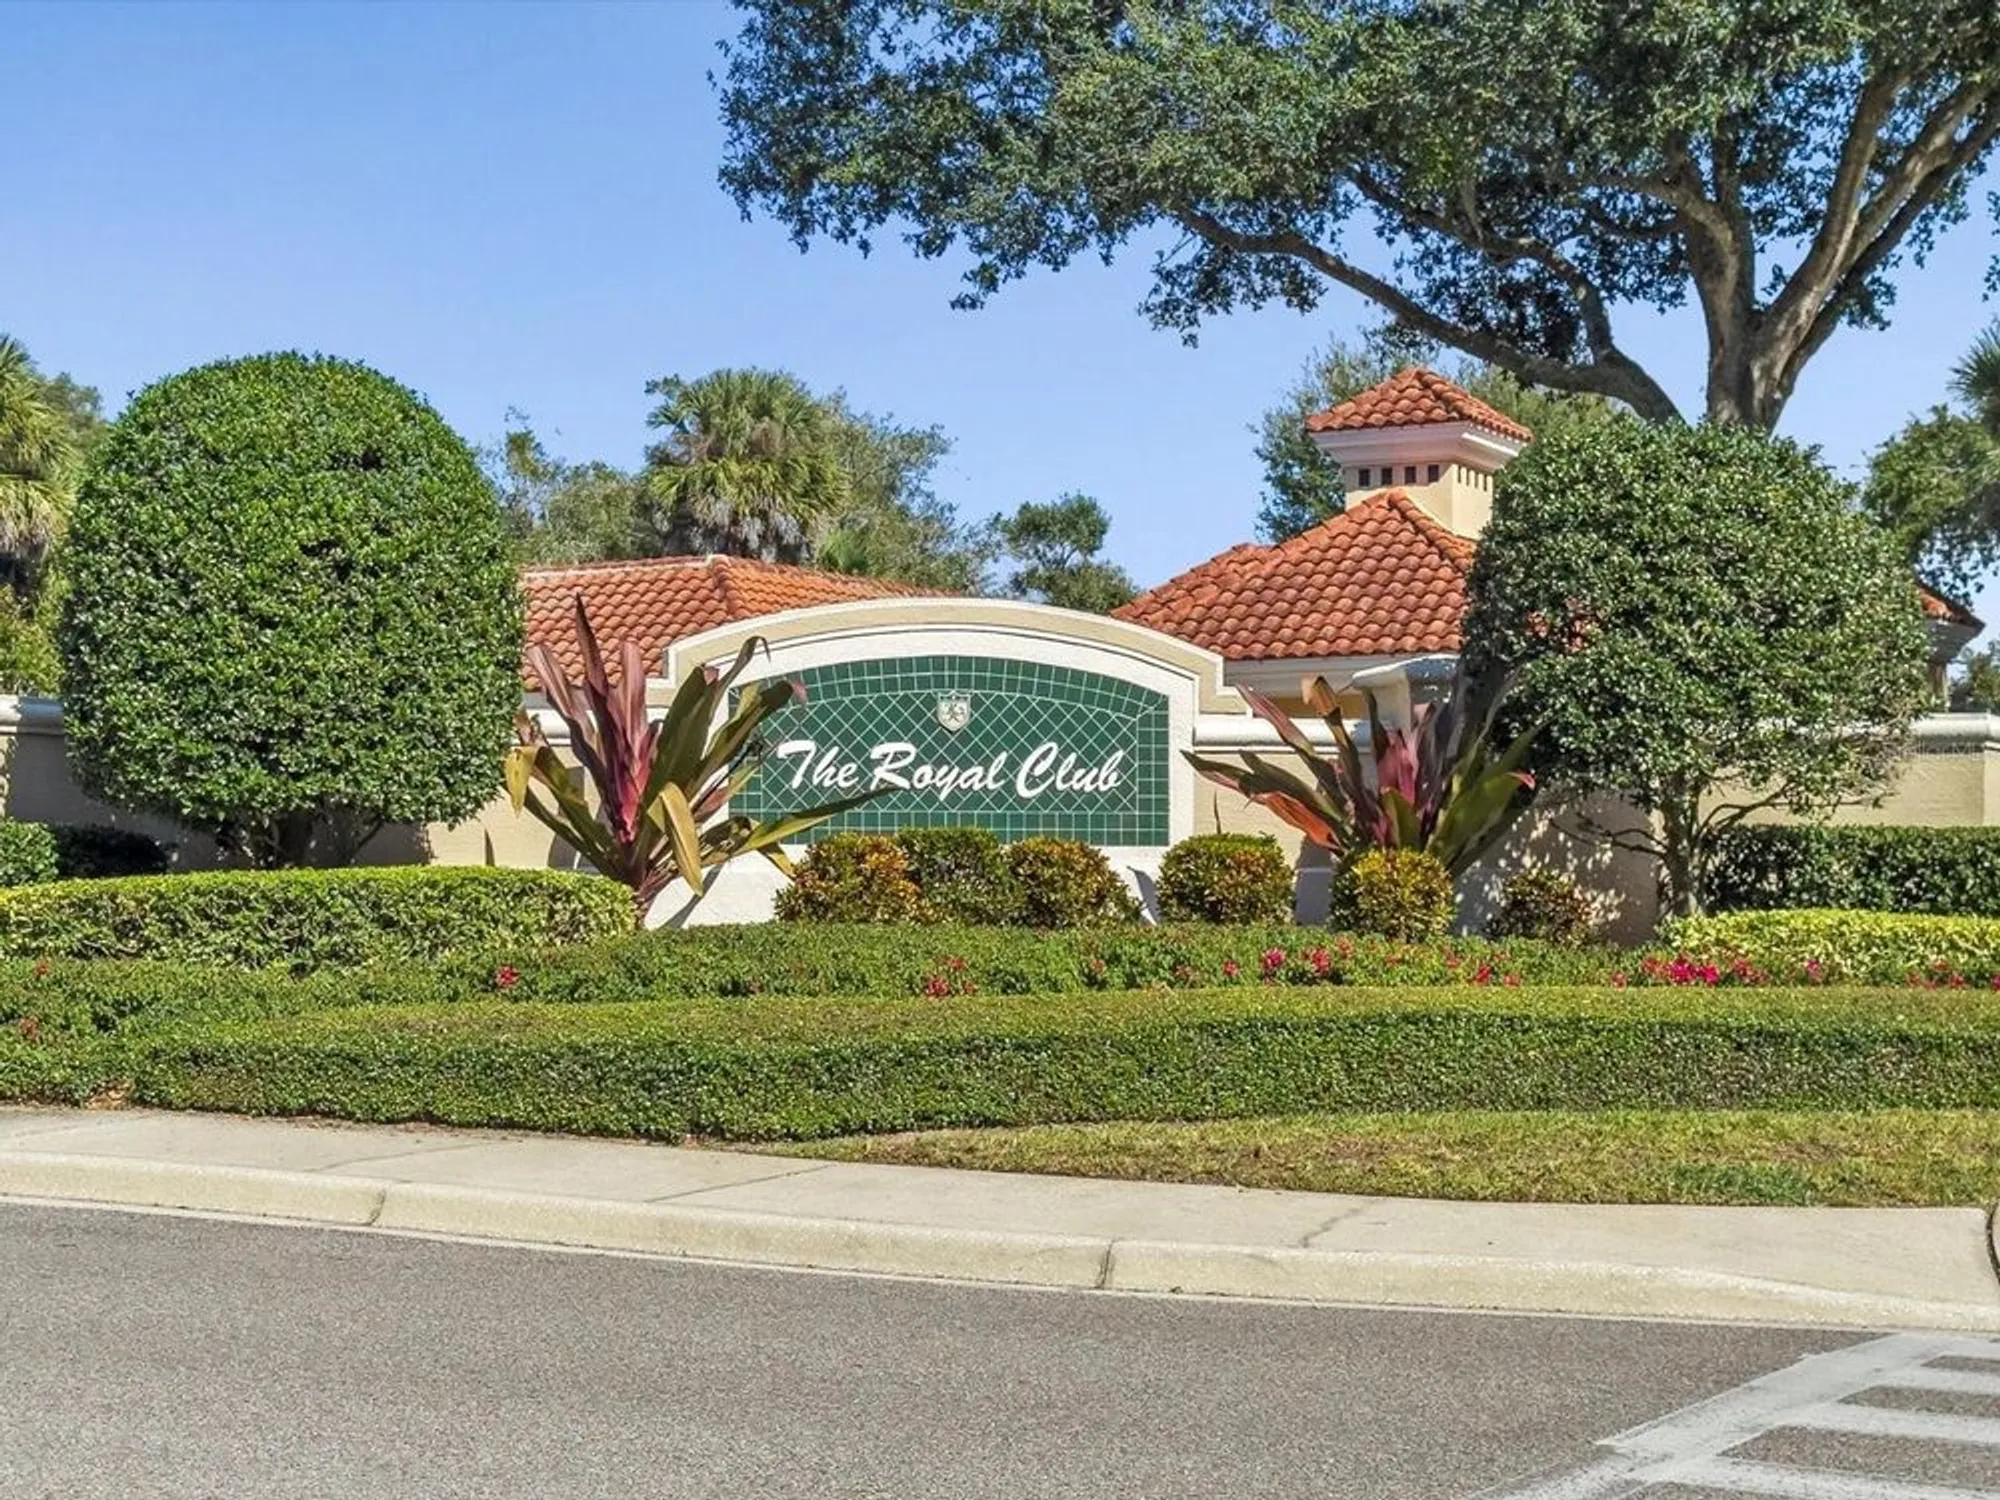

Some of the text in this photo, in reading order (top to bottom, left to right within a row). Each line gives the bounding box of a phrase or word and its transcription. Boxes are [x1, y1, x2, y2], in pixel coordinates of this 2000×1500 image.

[776, 740, 1125, 801] The Royal Club
